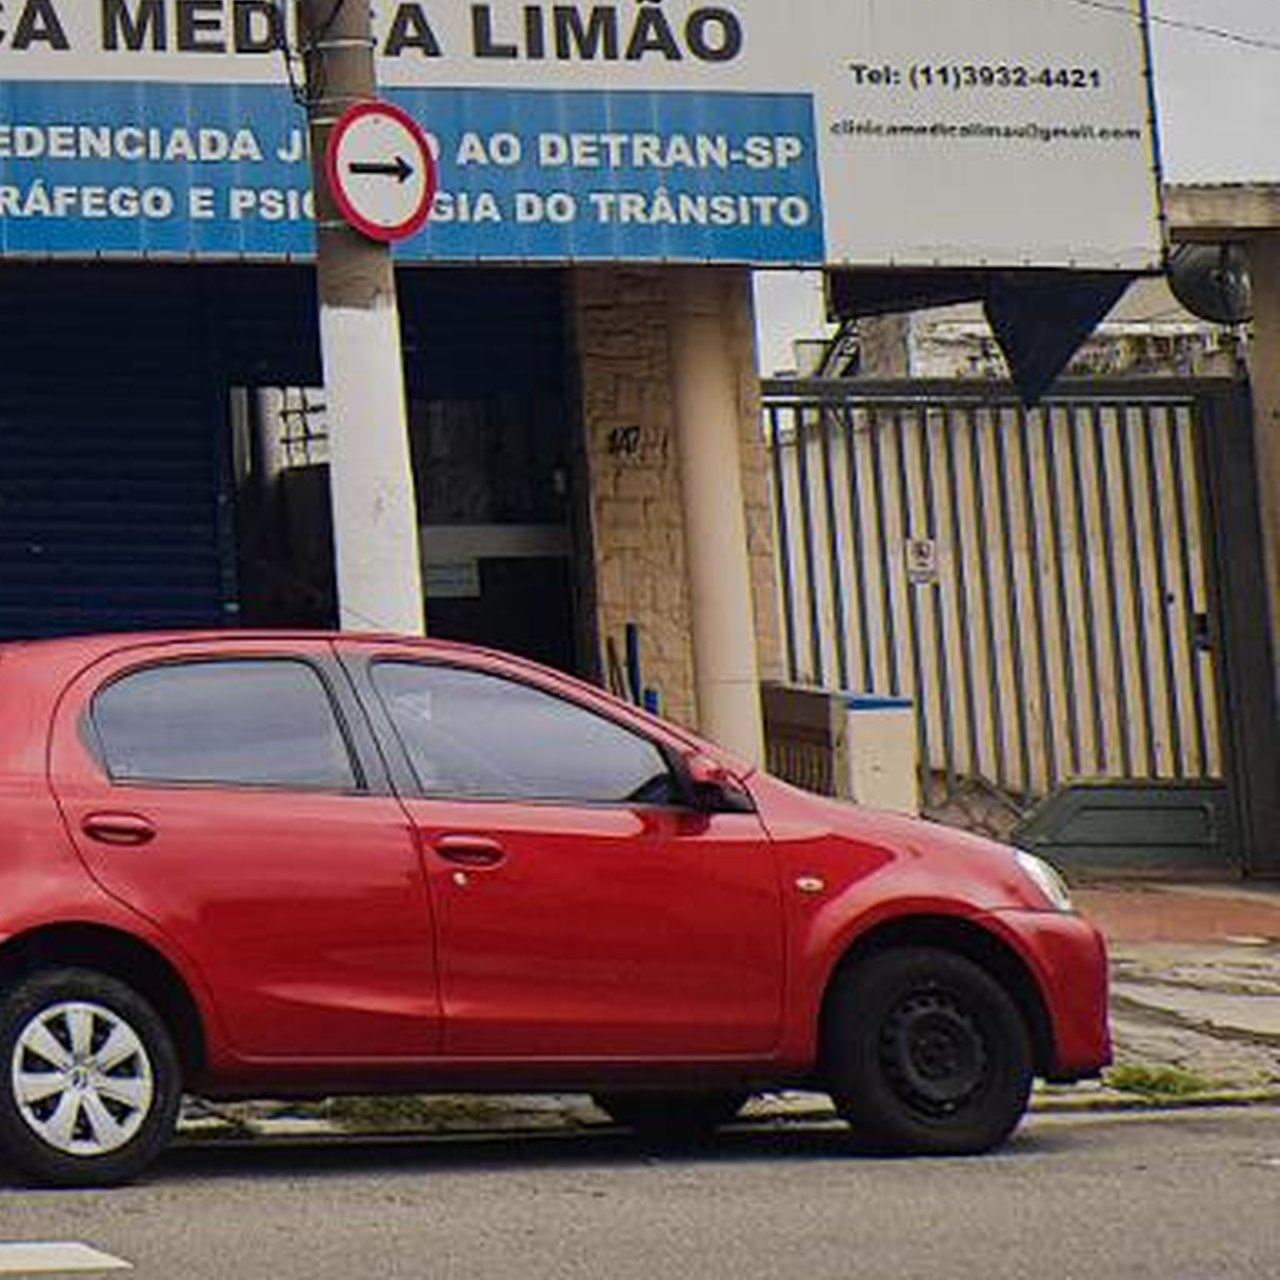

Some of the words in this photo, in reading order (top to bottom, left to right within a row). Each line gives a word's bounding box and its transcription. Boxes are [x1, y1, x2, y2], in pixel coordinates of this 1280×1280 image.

[848, 63, 901, 86] Tel:
[456, 133, 522, 166] AO
[539, 134, 804, 169] DETRAN-SP
[190, 187, 215, 220] E
[230, 189, 502, 225] PSIGIA
[516, 192, 578, 224] DO
[590, 185, 811, 227] TRÂNSITO
